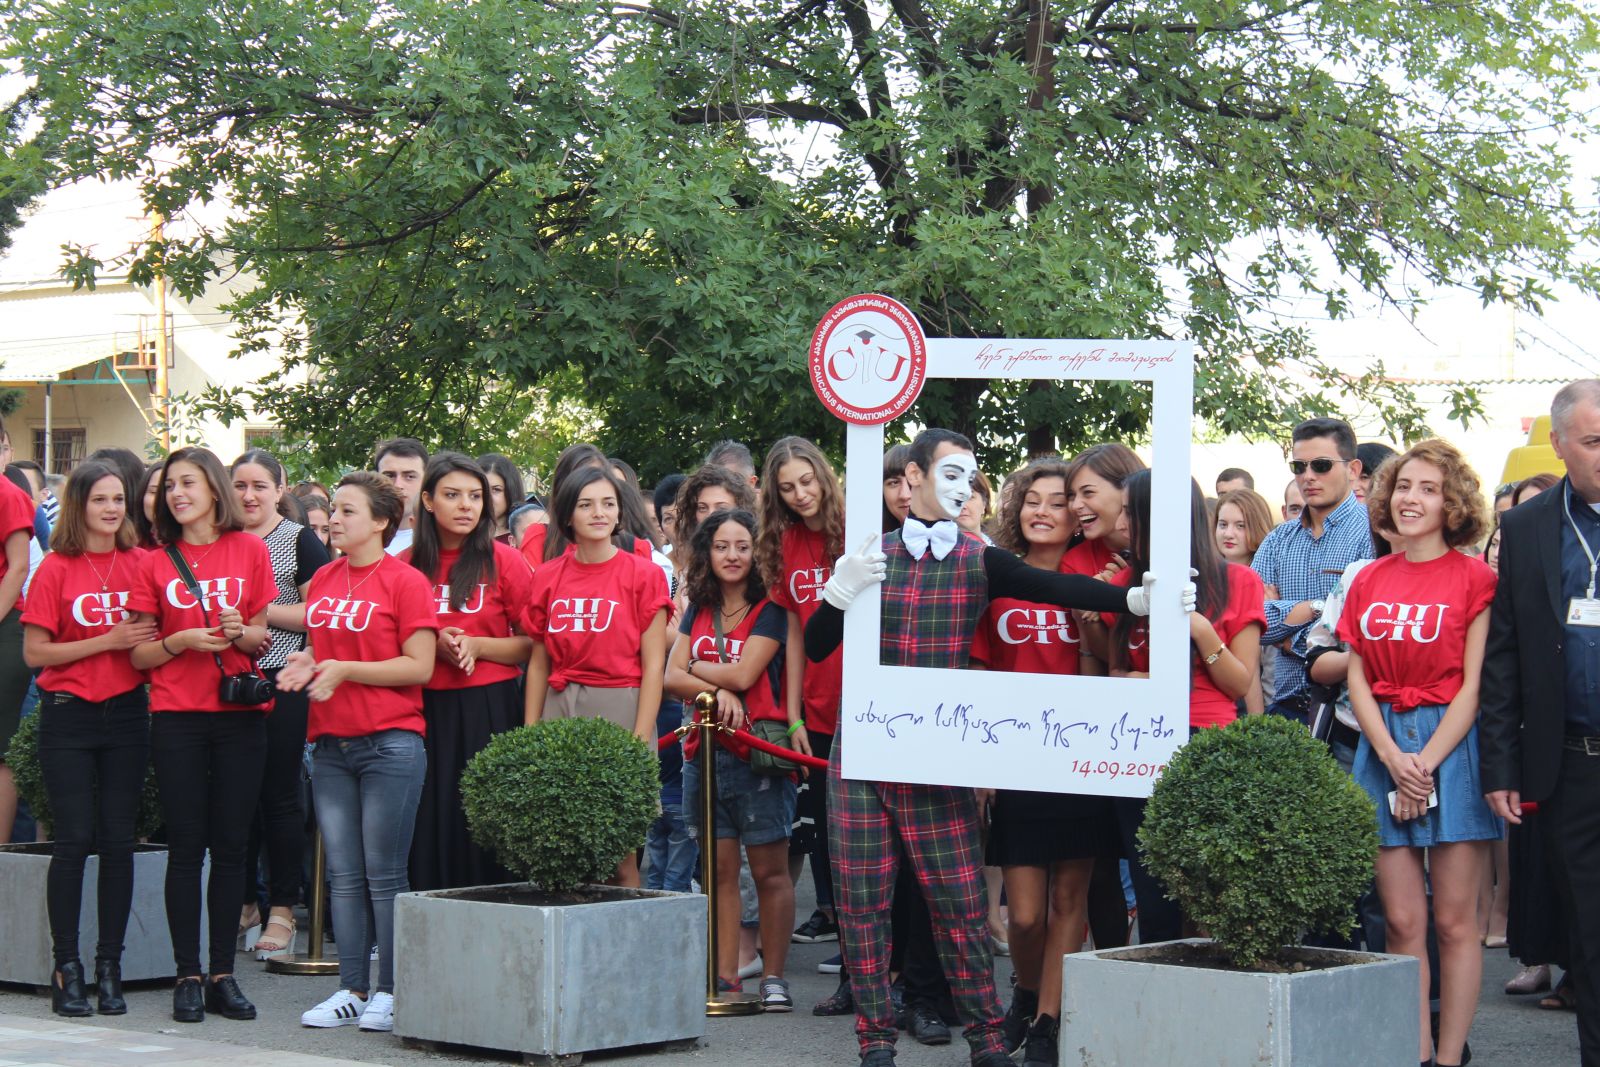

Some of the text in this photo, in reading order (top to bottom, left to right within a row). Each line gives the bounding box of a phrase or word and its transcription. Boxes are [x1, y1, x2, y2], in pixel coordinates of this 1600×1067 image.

[813, 365, 922, 421] CAUCASUS INTERNATIONAL UNIVERSITY
[166, 577, 246, 612] CIU
[789, 567, 831, 604] CI
[306, 596, 380, 632] CIU
[547, 598, 620, 633] CIU
[1360, 602, 1450, 644] CIU
[855, 701, 923, 738] ახალი
[934, 702, 1031, 744] სასწავლო
[1041, 708, 1099, 748] წელი
